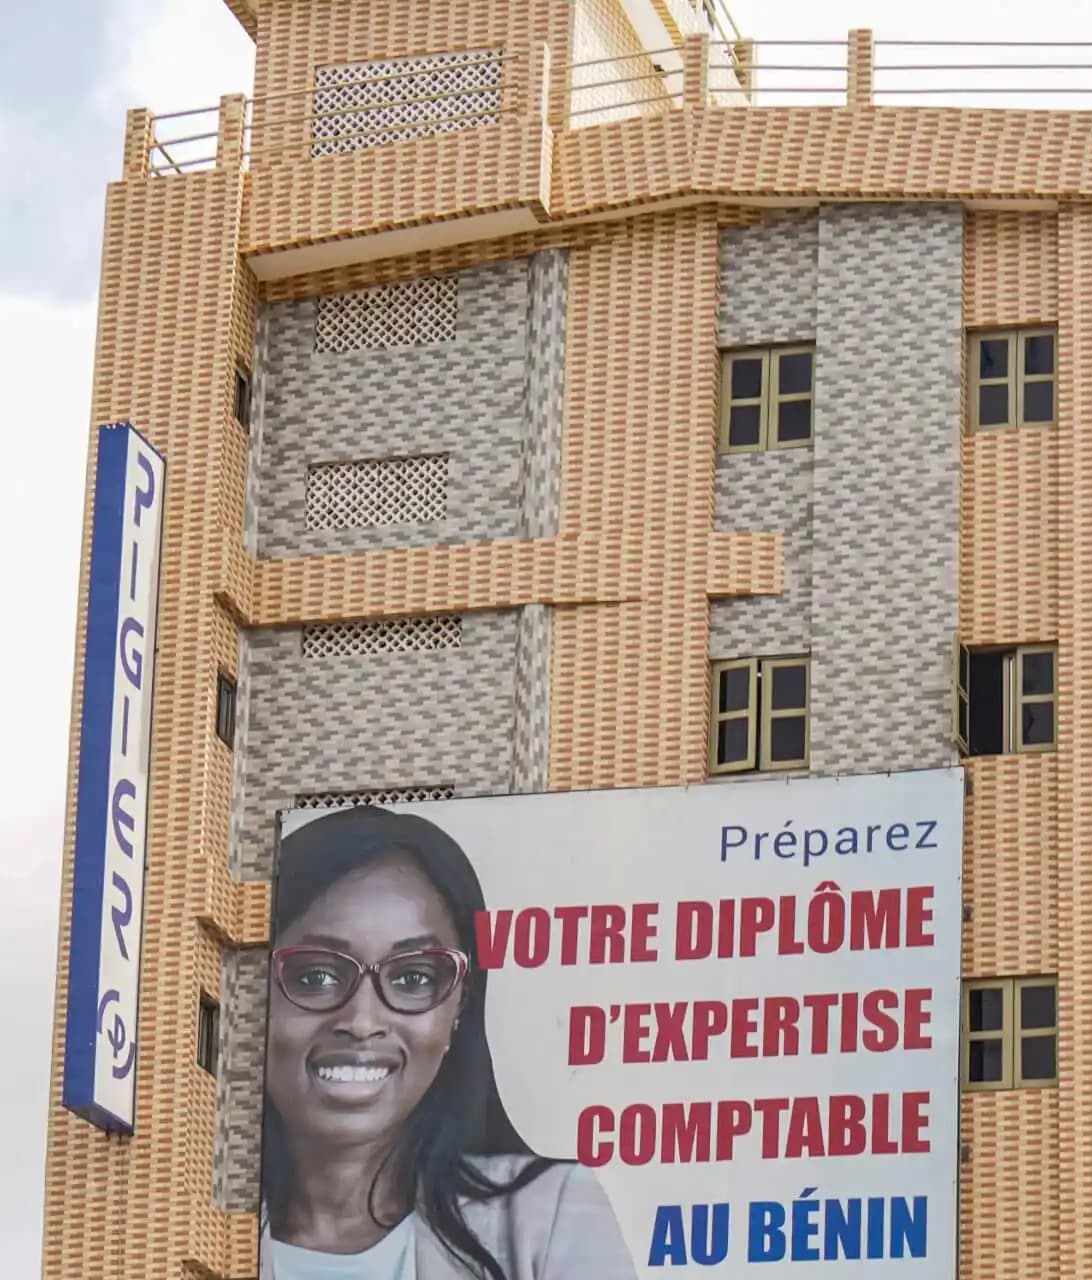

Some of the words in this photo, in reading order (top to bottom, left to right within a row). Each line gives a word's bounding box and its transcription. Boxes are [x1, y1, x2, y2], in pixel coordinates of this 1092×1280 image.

[109, 451, 156, 960] PIGIER
[720, 818, 938, 867] Préparez
[474, 902, 660, 970] VOTRE
[675, 880, 935, 961] DIPLÔME
[567, 987, 933, 1066] D'EXPERTISE
[576, 1091, 931, 1168] COMPTABLE
[647, 1202, 730, 1267] AU
[747, 1186, 928, 1263] BÉNIN
